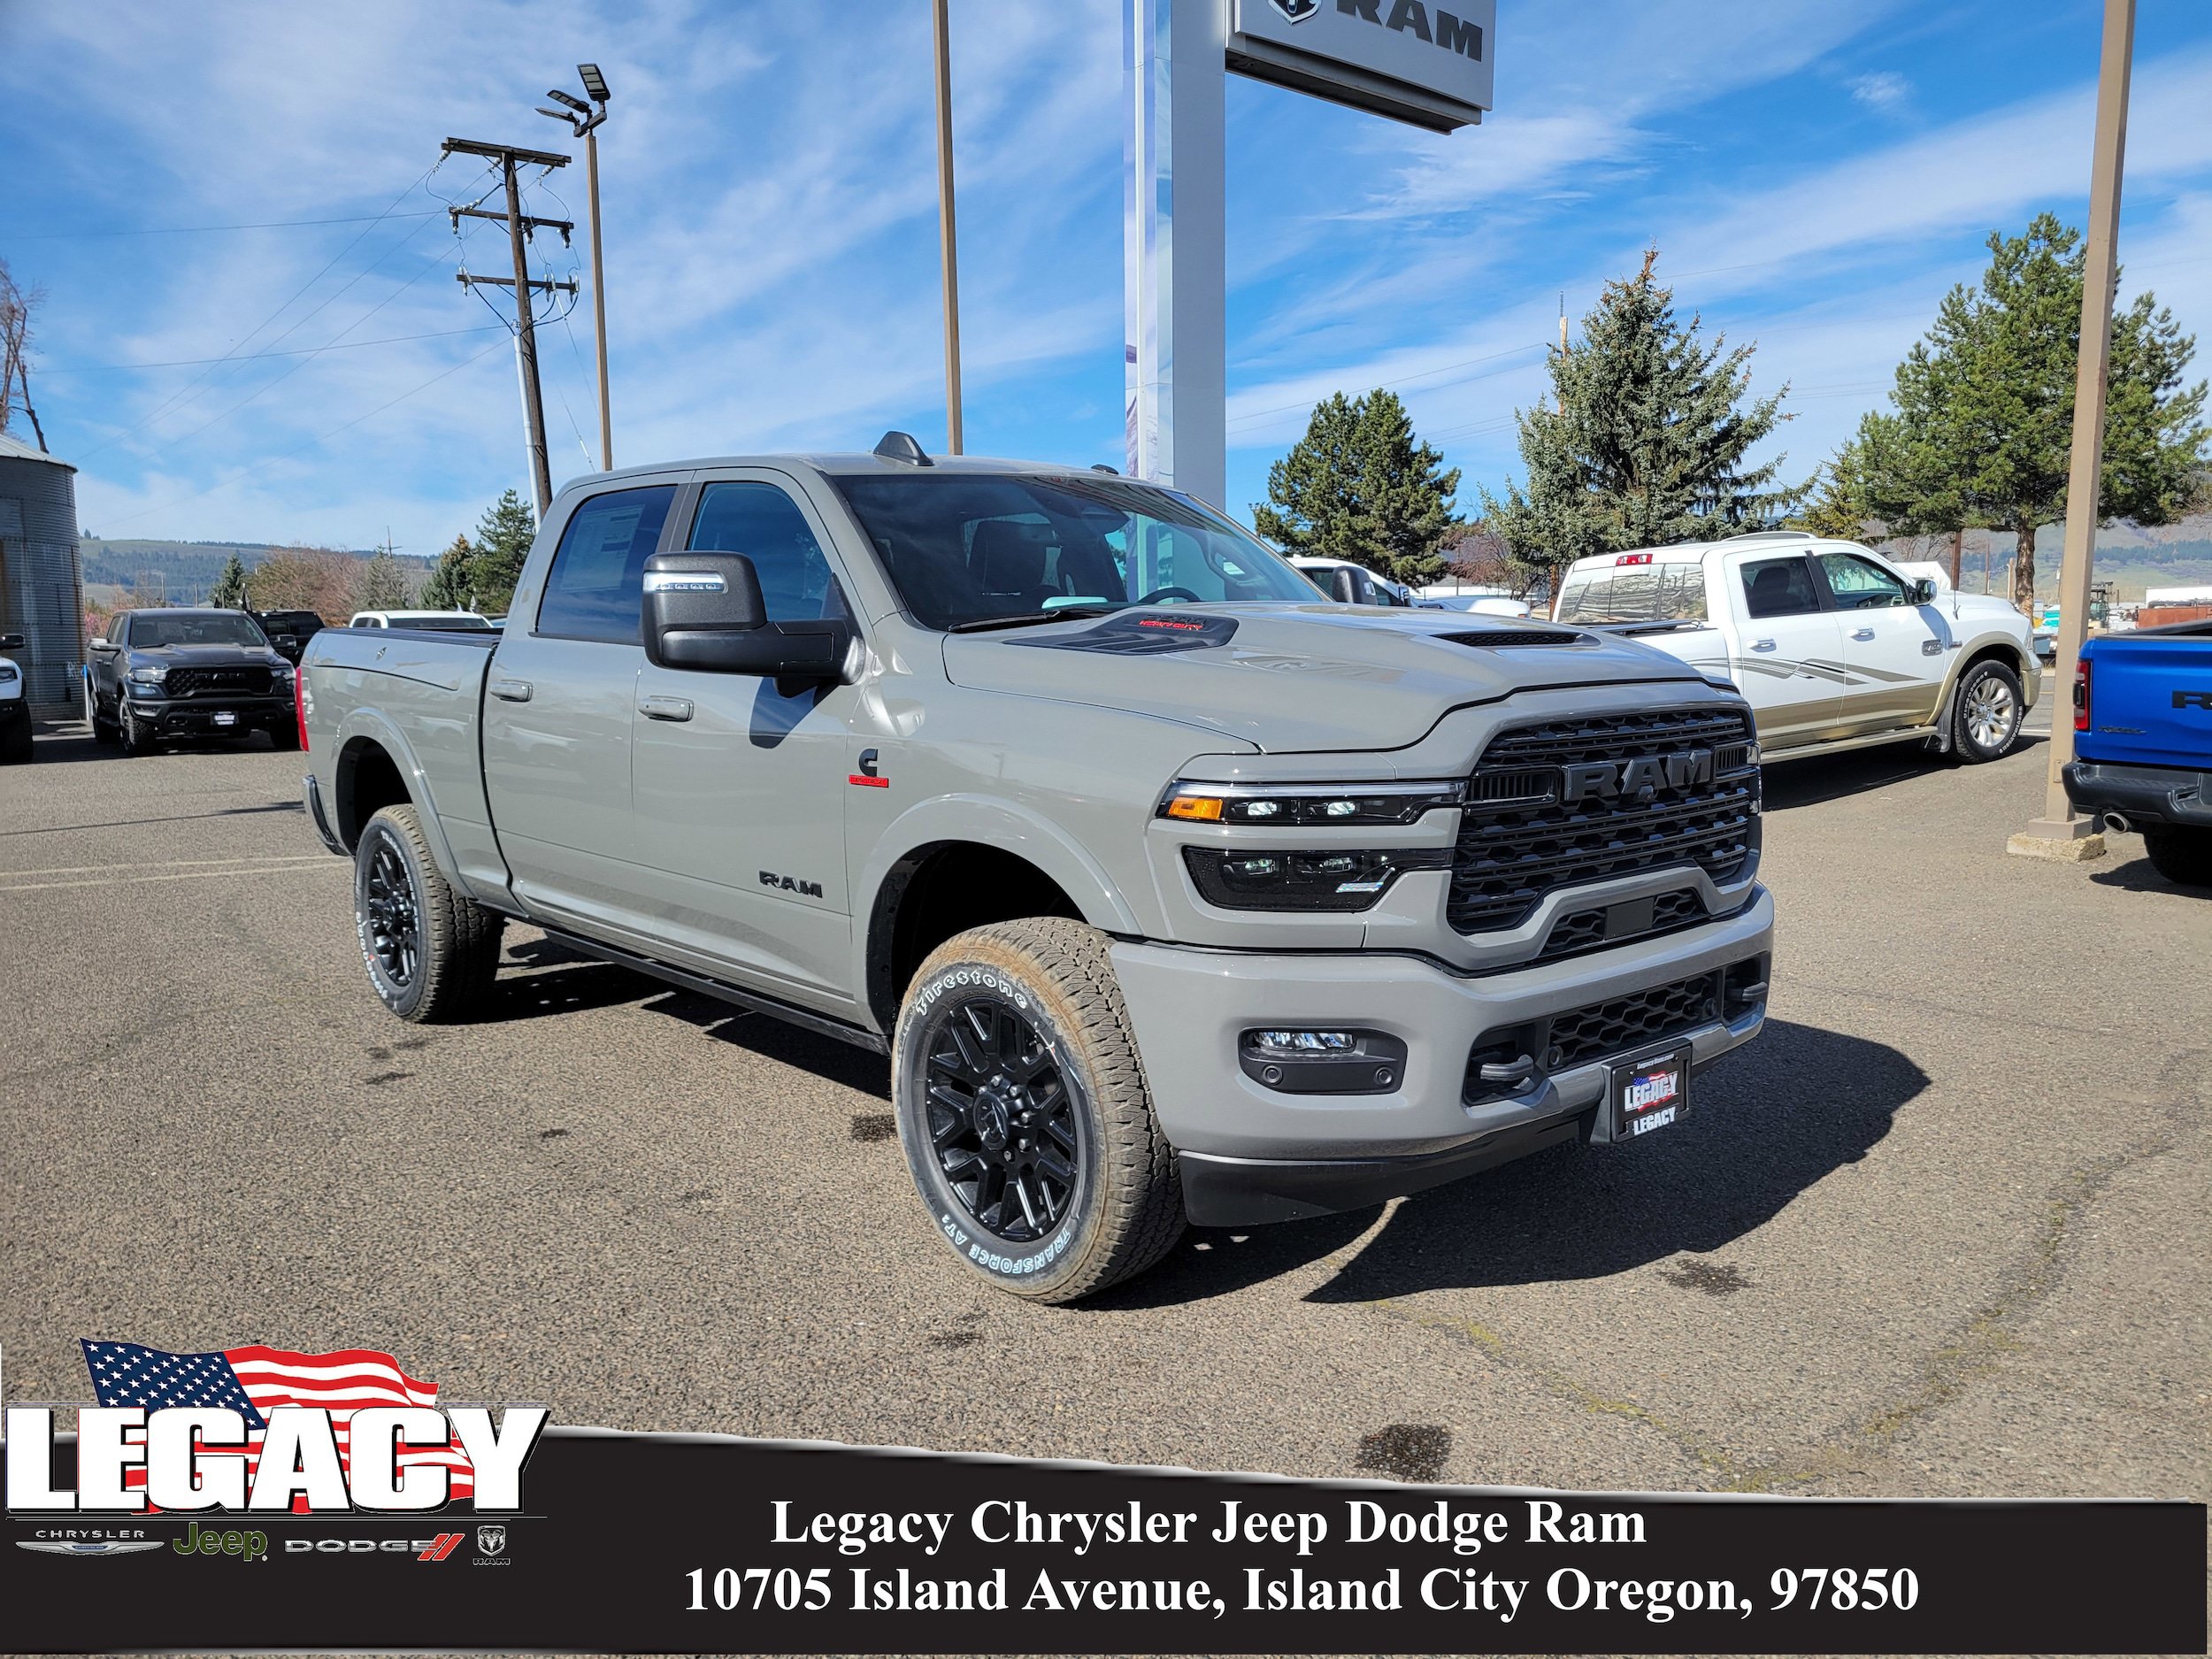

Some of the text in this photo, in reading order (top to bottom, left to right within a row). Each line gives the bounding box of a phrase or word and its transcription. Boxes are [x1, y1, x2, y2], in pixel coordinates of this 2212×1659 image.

[1563, 749, 1712, 802] RAM
[758, 870, 823, 898] RAM
[915, 968, 1029, 1017] Firestone
[1624, 1071, 1678, 1110] LEGACY
[1632, 1106, 1677, 1136] LEGACY
[968, 1225, 1071, 1276] TRANSFORCE
